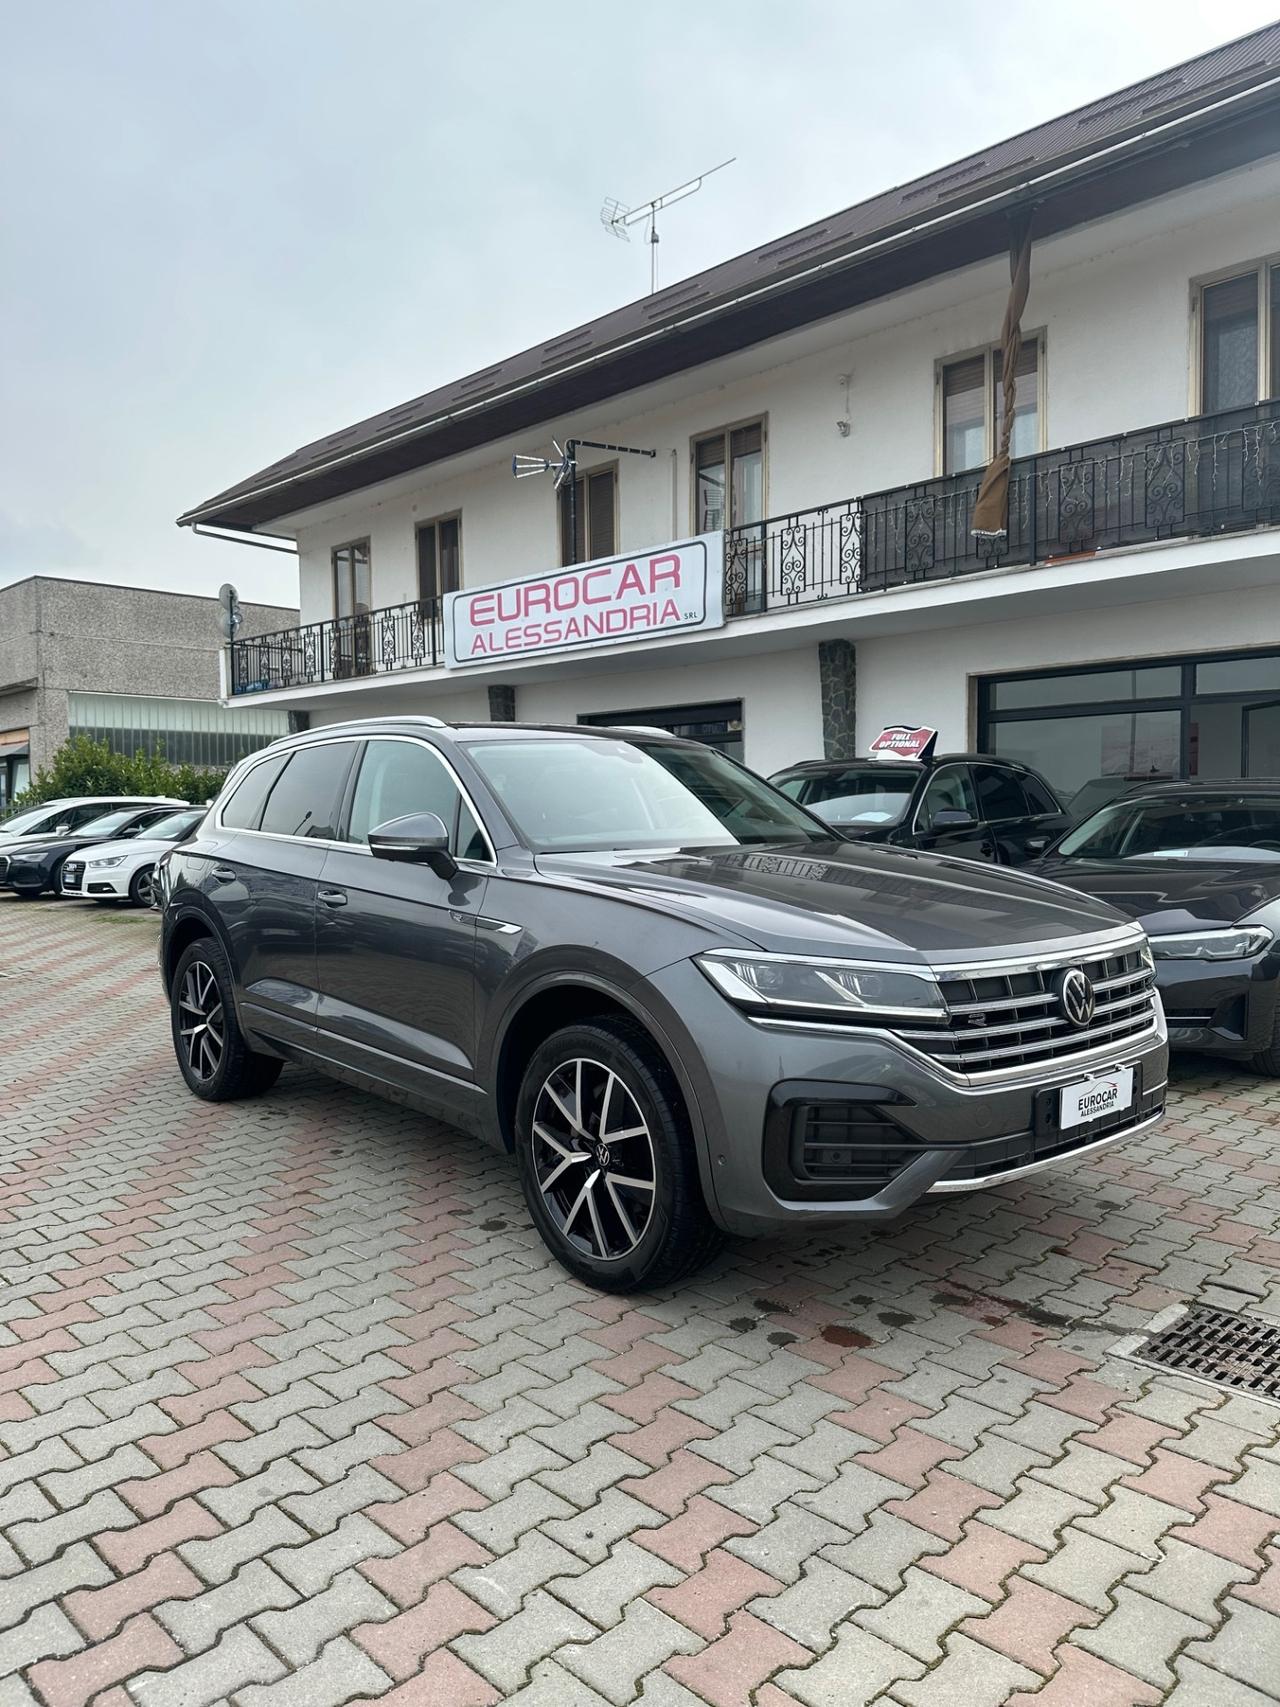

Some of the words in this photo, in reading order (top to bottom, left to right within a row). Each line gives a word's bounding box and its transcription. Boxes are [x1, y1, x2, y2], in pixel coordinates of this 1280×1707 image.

[469, 554, 681, 627] EUROCAR
[470, 599, 681, 655] ALESSANDRIA
[684, 611, 698, 620] SRL
[879, 740, 920, 748] OPTIONAL
[1078, 1088, 1118, 1111] EUROCAR
[1080, 1101, 1115, 1117] ALESSANDRIA
